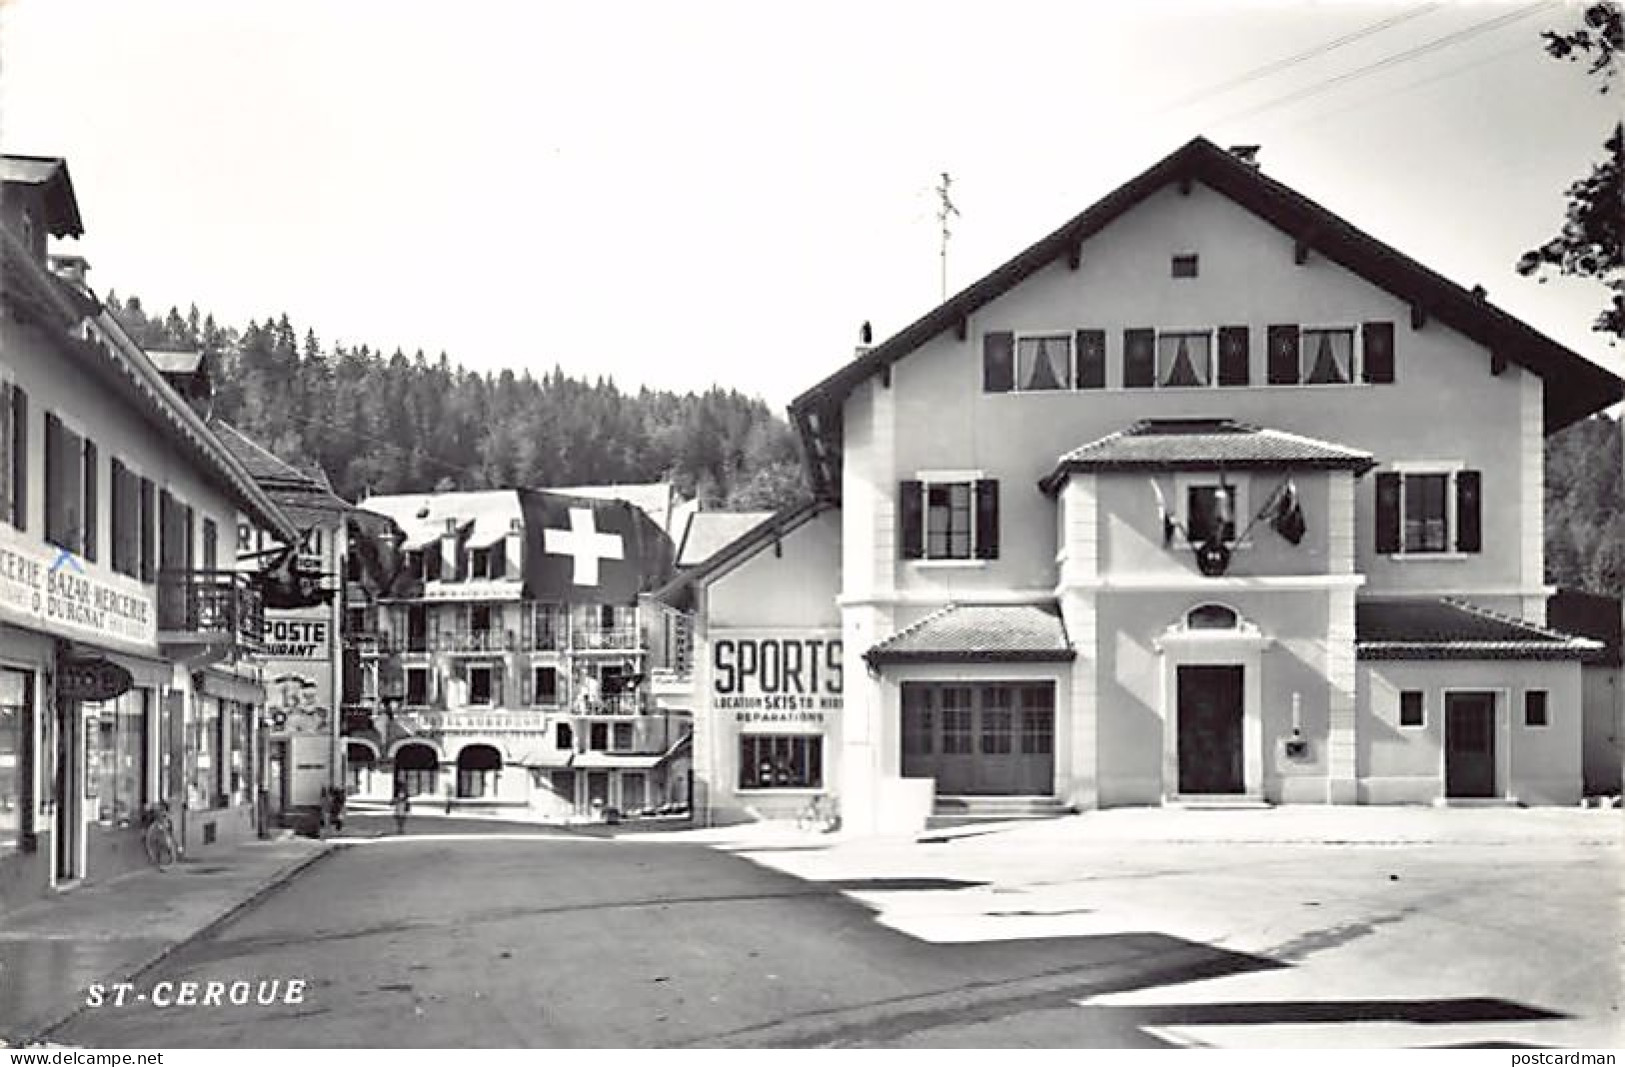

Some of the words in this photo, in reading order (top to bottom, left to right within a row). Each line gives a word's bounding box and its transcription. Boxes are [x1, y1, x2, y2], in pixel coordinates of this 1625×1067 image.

[47, 567, 90, 604] BAZAR
[262, 621, 326, 642] POSTE
[714, 639, 843, 694] SPORTS
[714, 696, 762, 709] LOCATION
[764, 694, 798, 710] SKIS
